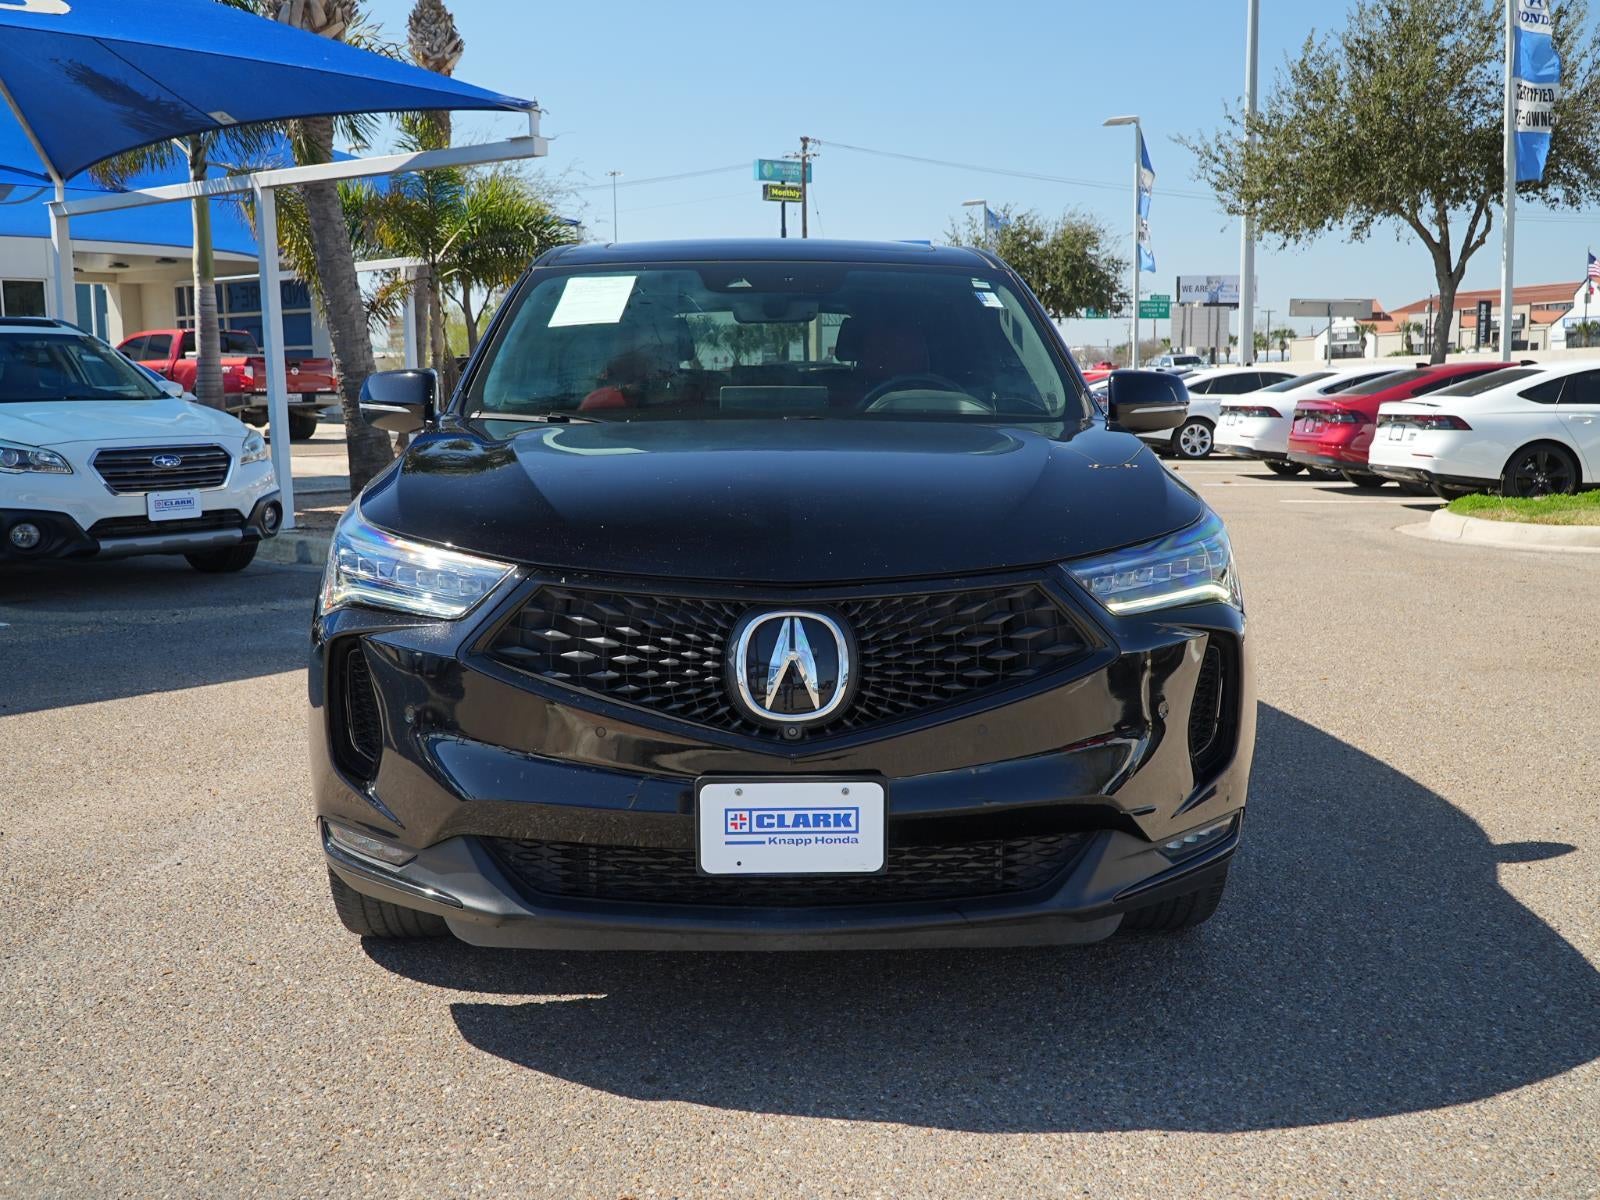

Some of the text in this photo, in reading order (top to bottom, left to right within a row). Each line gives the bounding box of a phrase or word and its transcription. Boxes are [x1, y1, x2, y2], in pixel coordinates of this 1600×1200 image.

[1517, 11, 1554, 26] OND
[771, 188, 800, 198] Monthly
[1182, 285, 1208, 293] WE ARE
[755, 812, 853, 829] CLARK
[768, 835, 859, 847] Knapp Honda
